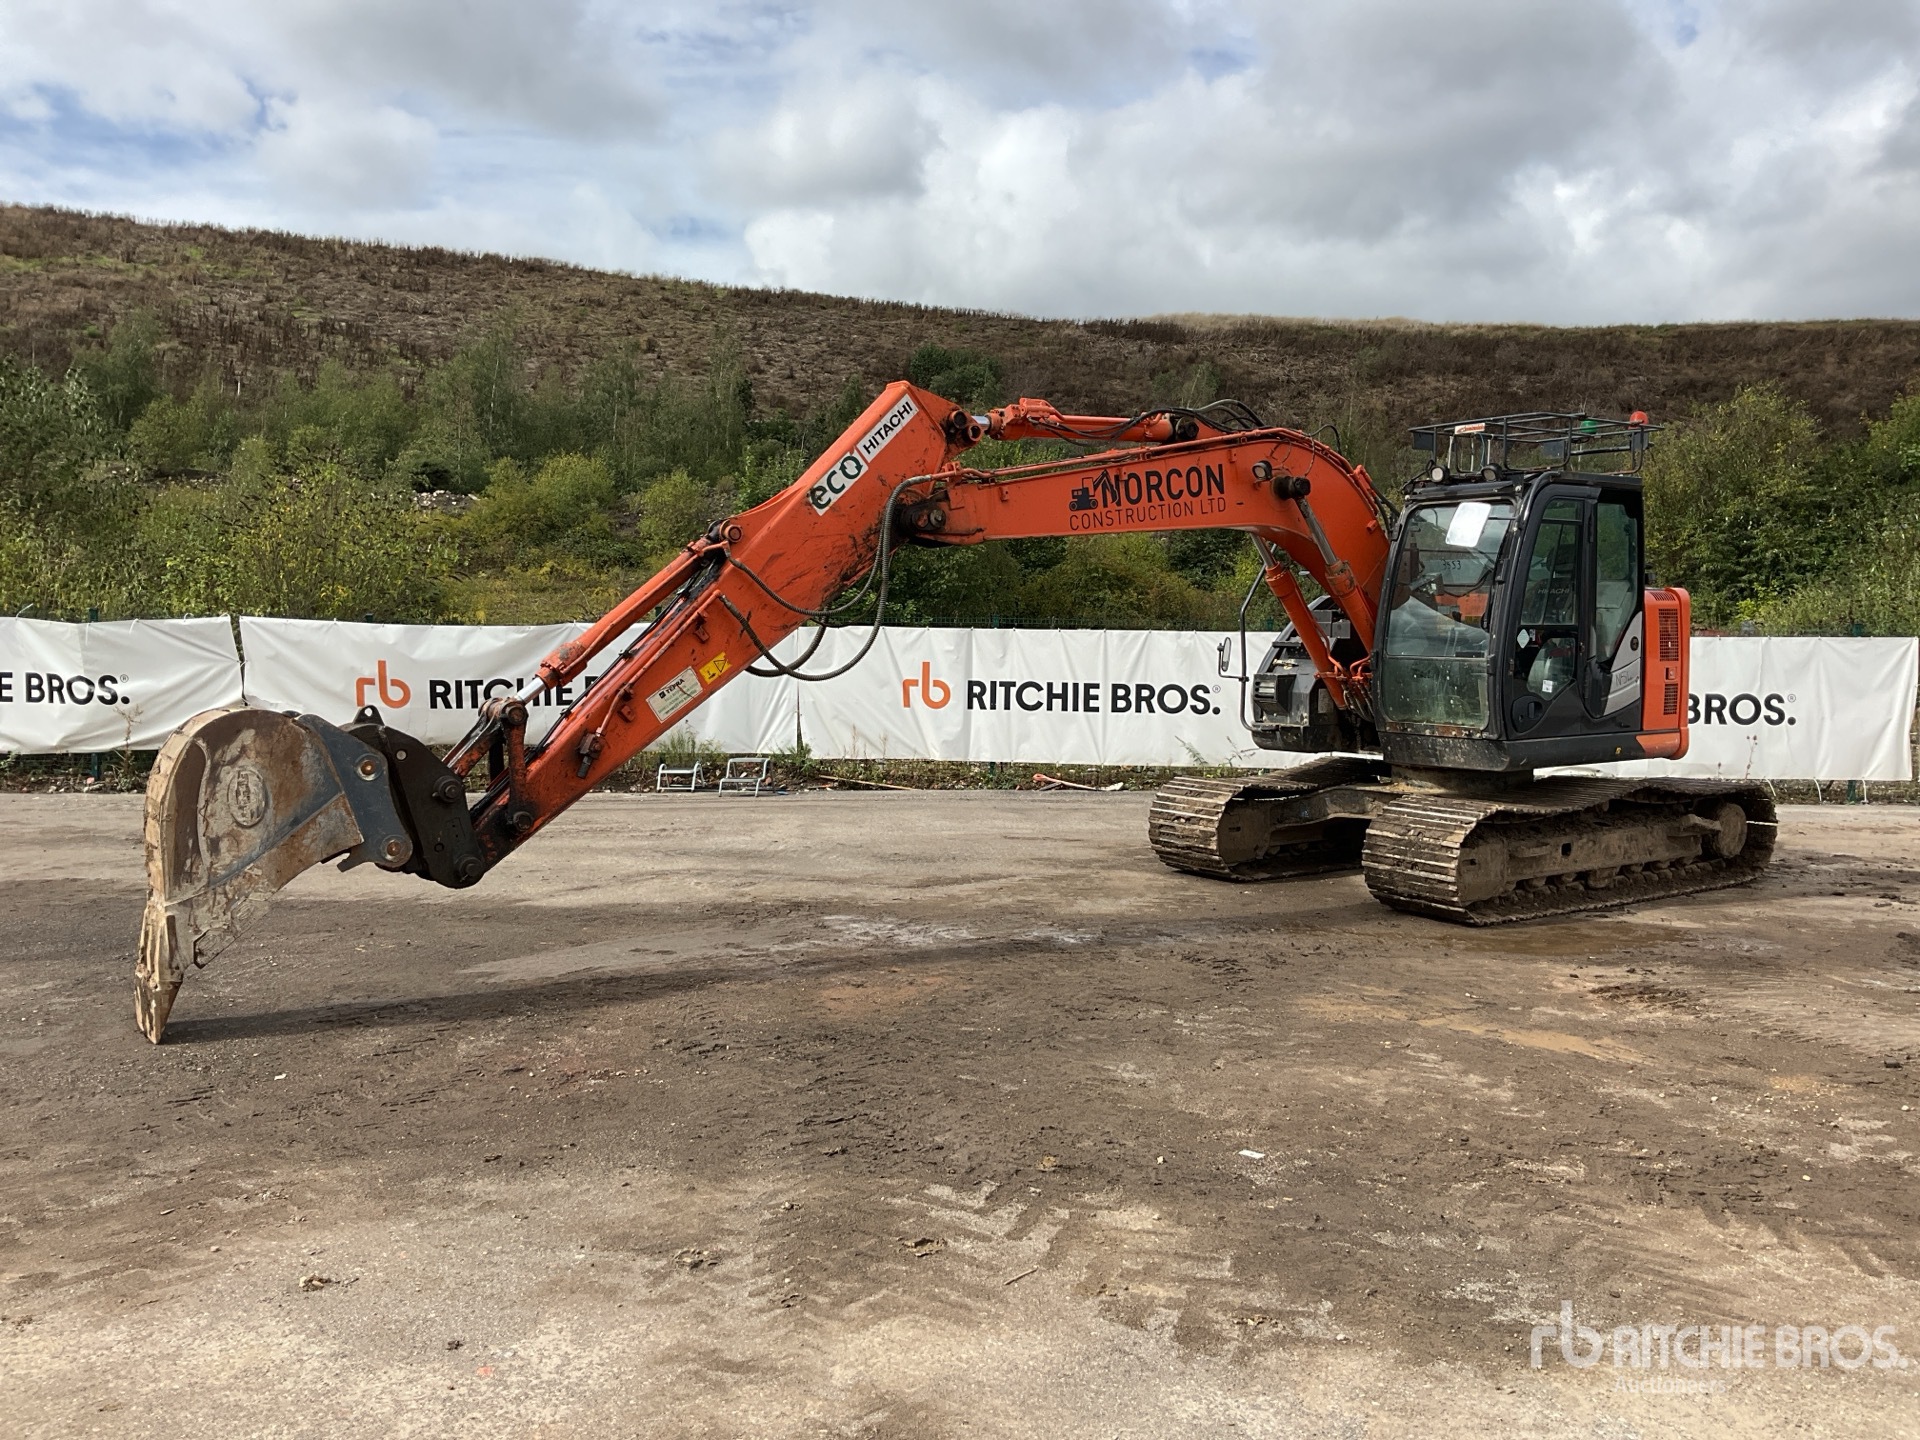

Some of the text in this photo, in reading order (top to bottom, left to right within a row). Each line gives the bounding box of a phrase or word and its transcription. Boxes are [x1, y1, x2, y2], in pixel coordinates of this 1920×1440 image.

[863, 401, 913, 454] HITACHI
[1102, 464, 1225, 508] NORCON
[1069, 497, 1226, 531] CONSTRUCTION LTD
[902, 661, 951, 709] rb
[967, 680, 1100, 713] RITCHIE
